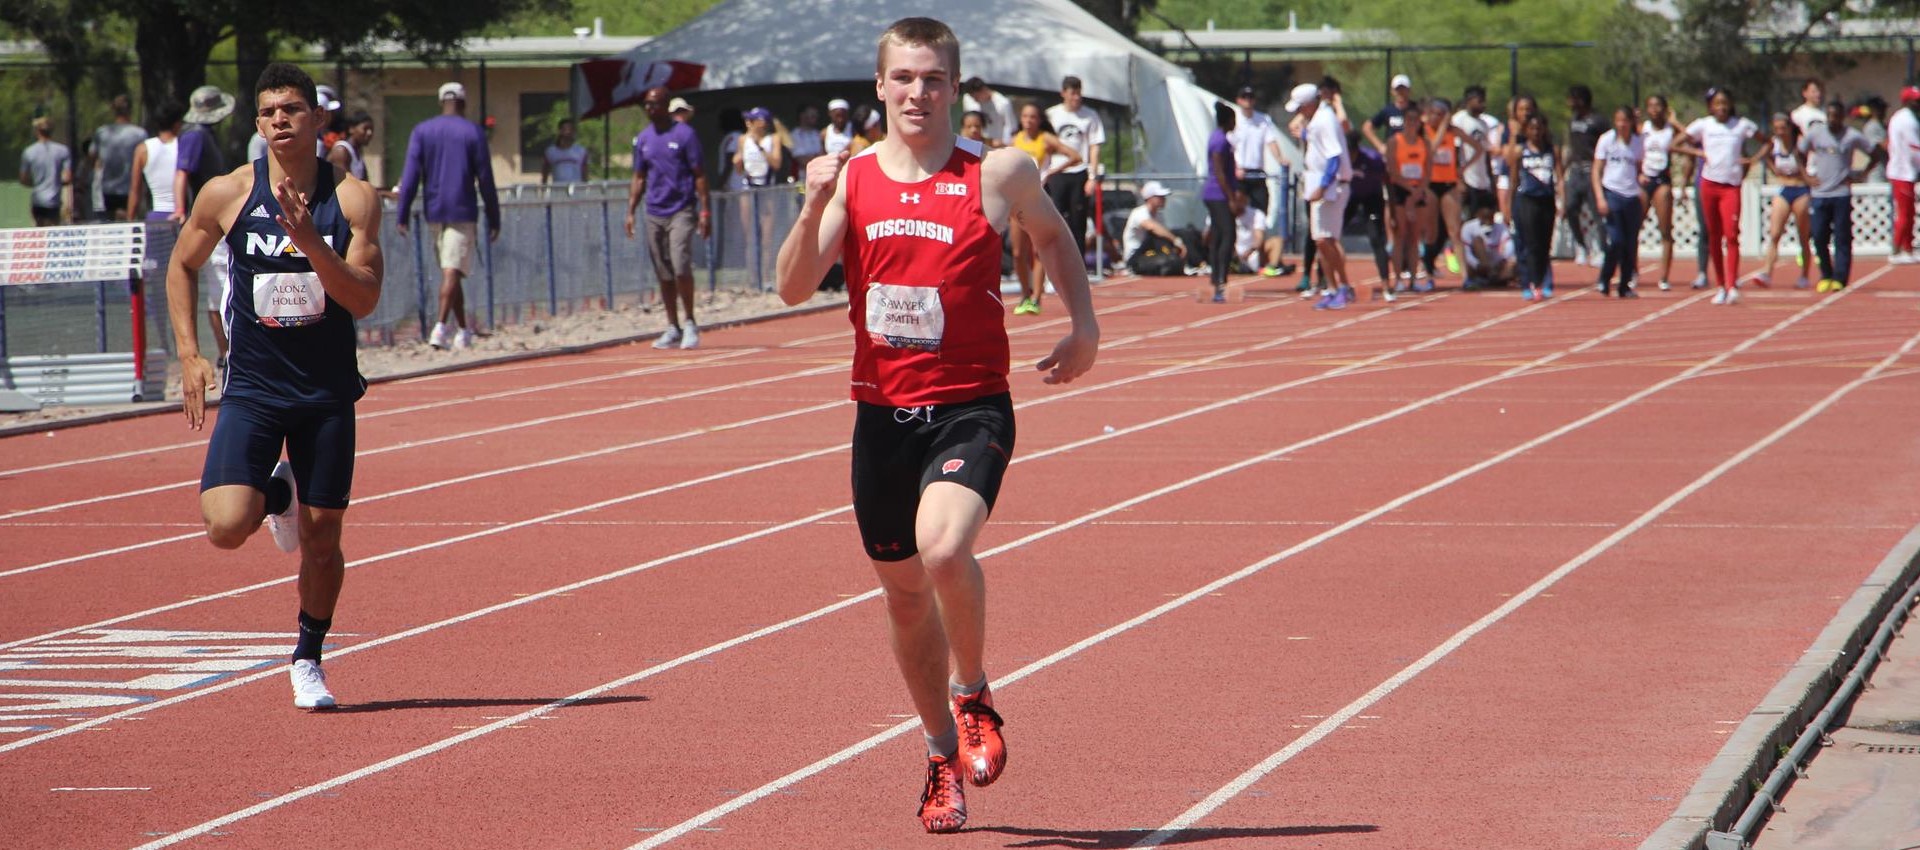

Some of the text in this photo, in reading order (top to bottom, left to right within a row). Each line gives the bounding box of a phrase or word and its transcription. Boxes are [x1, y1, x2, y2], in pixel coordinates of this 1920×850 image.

[250, 211, 270, 219] adidas
[47, 228, 88, 238] DOWN
[865, 219, 954, 245] WISCONSIN
[246, 232, 334, 258] NA
[43, 270, 84, 280] DOWN
[272, 285, 306, 294] ALONZ
[272, 296, 308, 306] HOLLIS
[880, 297, 927, 312] SAWYER
[885, 312, 920, 325] SMITH
